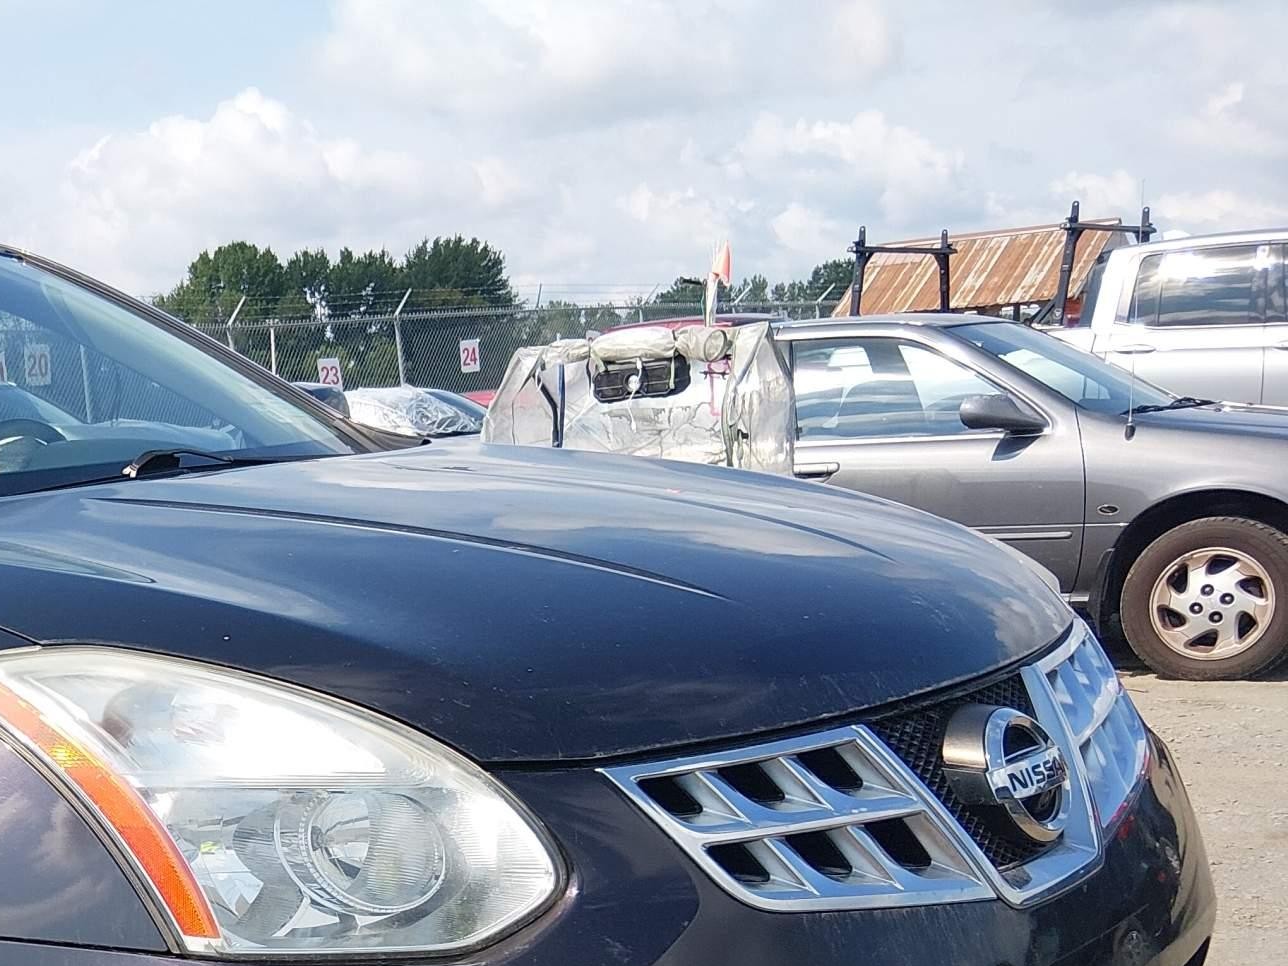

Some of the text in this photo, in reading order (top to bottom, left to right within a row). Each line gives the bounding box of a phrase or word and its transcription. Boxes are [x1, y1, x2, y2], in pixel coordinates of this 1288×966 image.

[28, 353, 48, 378] 20
[463, 347, 477, 366] 24
[321, 366, 339, 385] 23
[1007, 756, 1067, 792] NISSA
